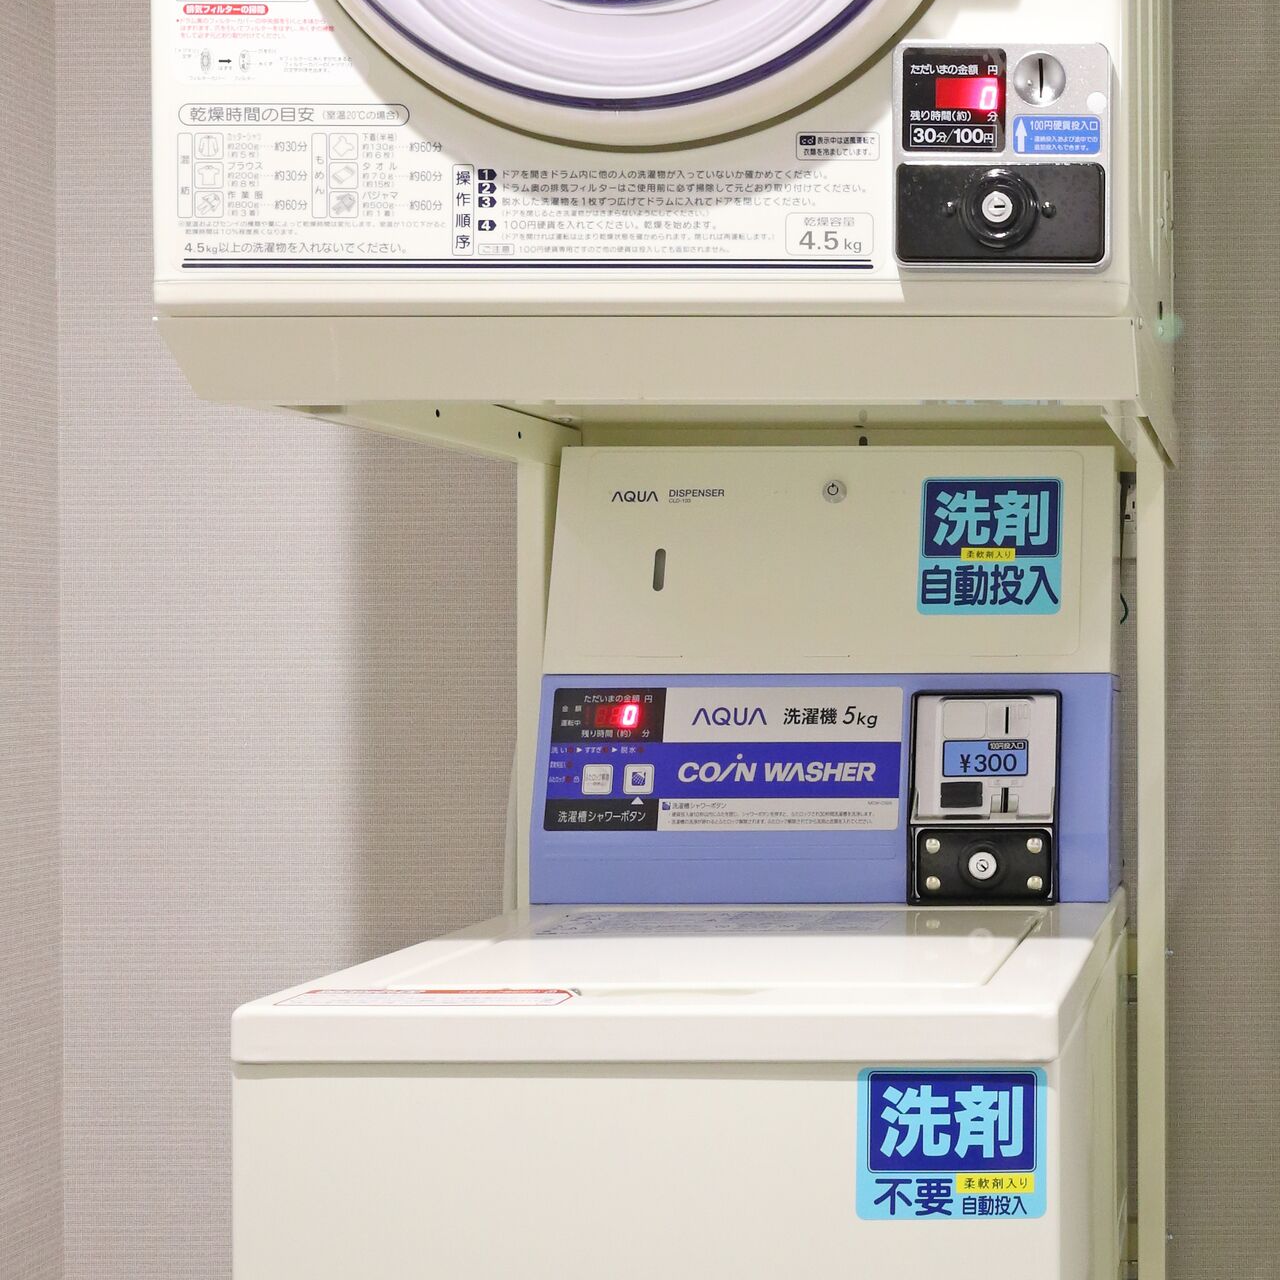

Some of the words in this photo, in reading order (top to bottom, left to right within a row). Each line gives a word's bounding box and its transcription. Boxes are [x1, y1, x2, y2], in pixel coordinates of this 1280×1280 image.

[910, 65, 978, 75] ただいまの金額
[988, 65, 998, 74] 円
[979, 86, 997, 110] 0
[190, 107, 314, 122] 乾燥時間の目安
[910, 111, 971, 121] 残り時間(約)
[987, 112, 998, 121] 分
[913, 128, 994, 143] 30分/100円
[274, 142, 307, 152] 約30分
[409, 142, 442, 152] 約60分
[274, 171, 307, 181] 約30分
[409, 171, 442, 181] 約60分
[482, 171, 489, 179] 1
[481, 184, 491, 193] 2
[274, 200, 307, 210] 約60分
[409, 200, 442, 211] 約60分
[481, 198, 491, 207] 3
[456, 171, 470, 249] 操作順序
[481, 221, 491, 230] 4
[800, 231, 839, 250] 4.5
[845, 238, 862, 253] kg
[612, 491, 658, 502] AQUA
[669, 489, 724, 497] DISPENSER
[933, 490, 1050, 547] 洗剤
[965, 550, 1012, 559] 柔軟剤入り
[921, 565, 1058, 606] 自動投入
[584, 695, 640, 703] ただいまの金額
[644, 695, 652, 703] 円
[622, 705, 639, 726] 0
[692, 708, 768, 726] AQUA
[783, 708, 837, 725] 洗濯機
[842, 706, 878, 728] 5kg
[581, 730, 631, 738] 残り時間(約)
[642, 729, 650, 737] 分
[960, 754, 1017, 773] ¥300
[765, 762, 876, 782] WASHER
[558, 811, 646, 823] 洗濯槽シャワーボタン
[880, 1085, 1023, 1158] 洗剤
[964, 1178, 1028, 1189] 柔軟剤入り
[874, 1179, 953, 1215] 不要
[962, 1196, 1027, 1215] 自動投入
